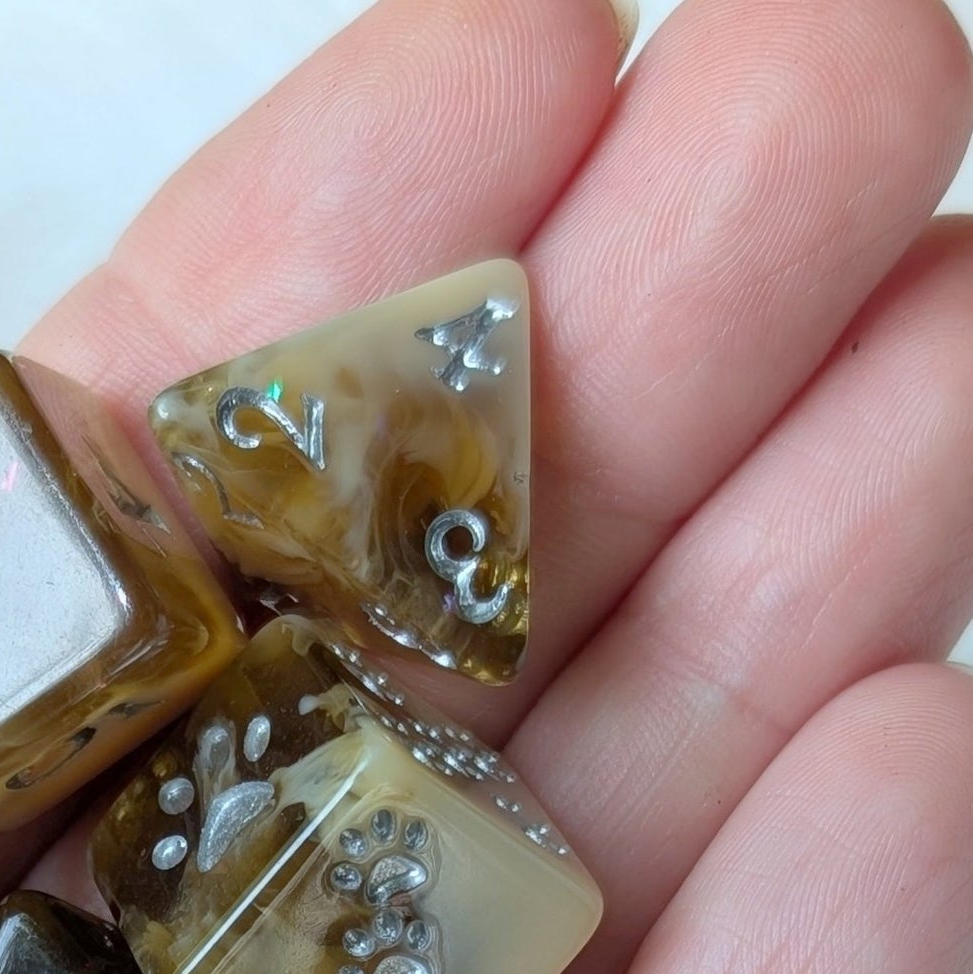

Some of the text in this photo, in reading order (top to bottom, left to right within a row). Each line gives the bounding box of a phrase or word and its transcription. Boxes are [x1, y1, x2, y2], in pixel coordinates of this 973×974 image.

[414, 298, 519, 392] 4
[216, 385, 325, 471] 2
[426, 509, 513, 624] 3
